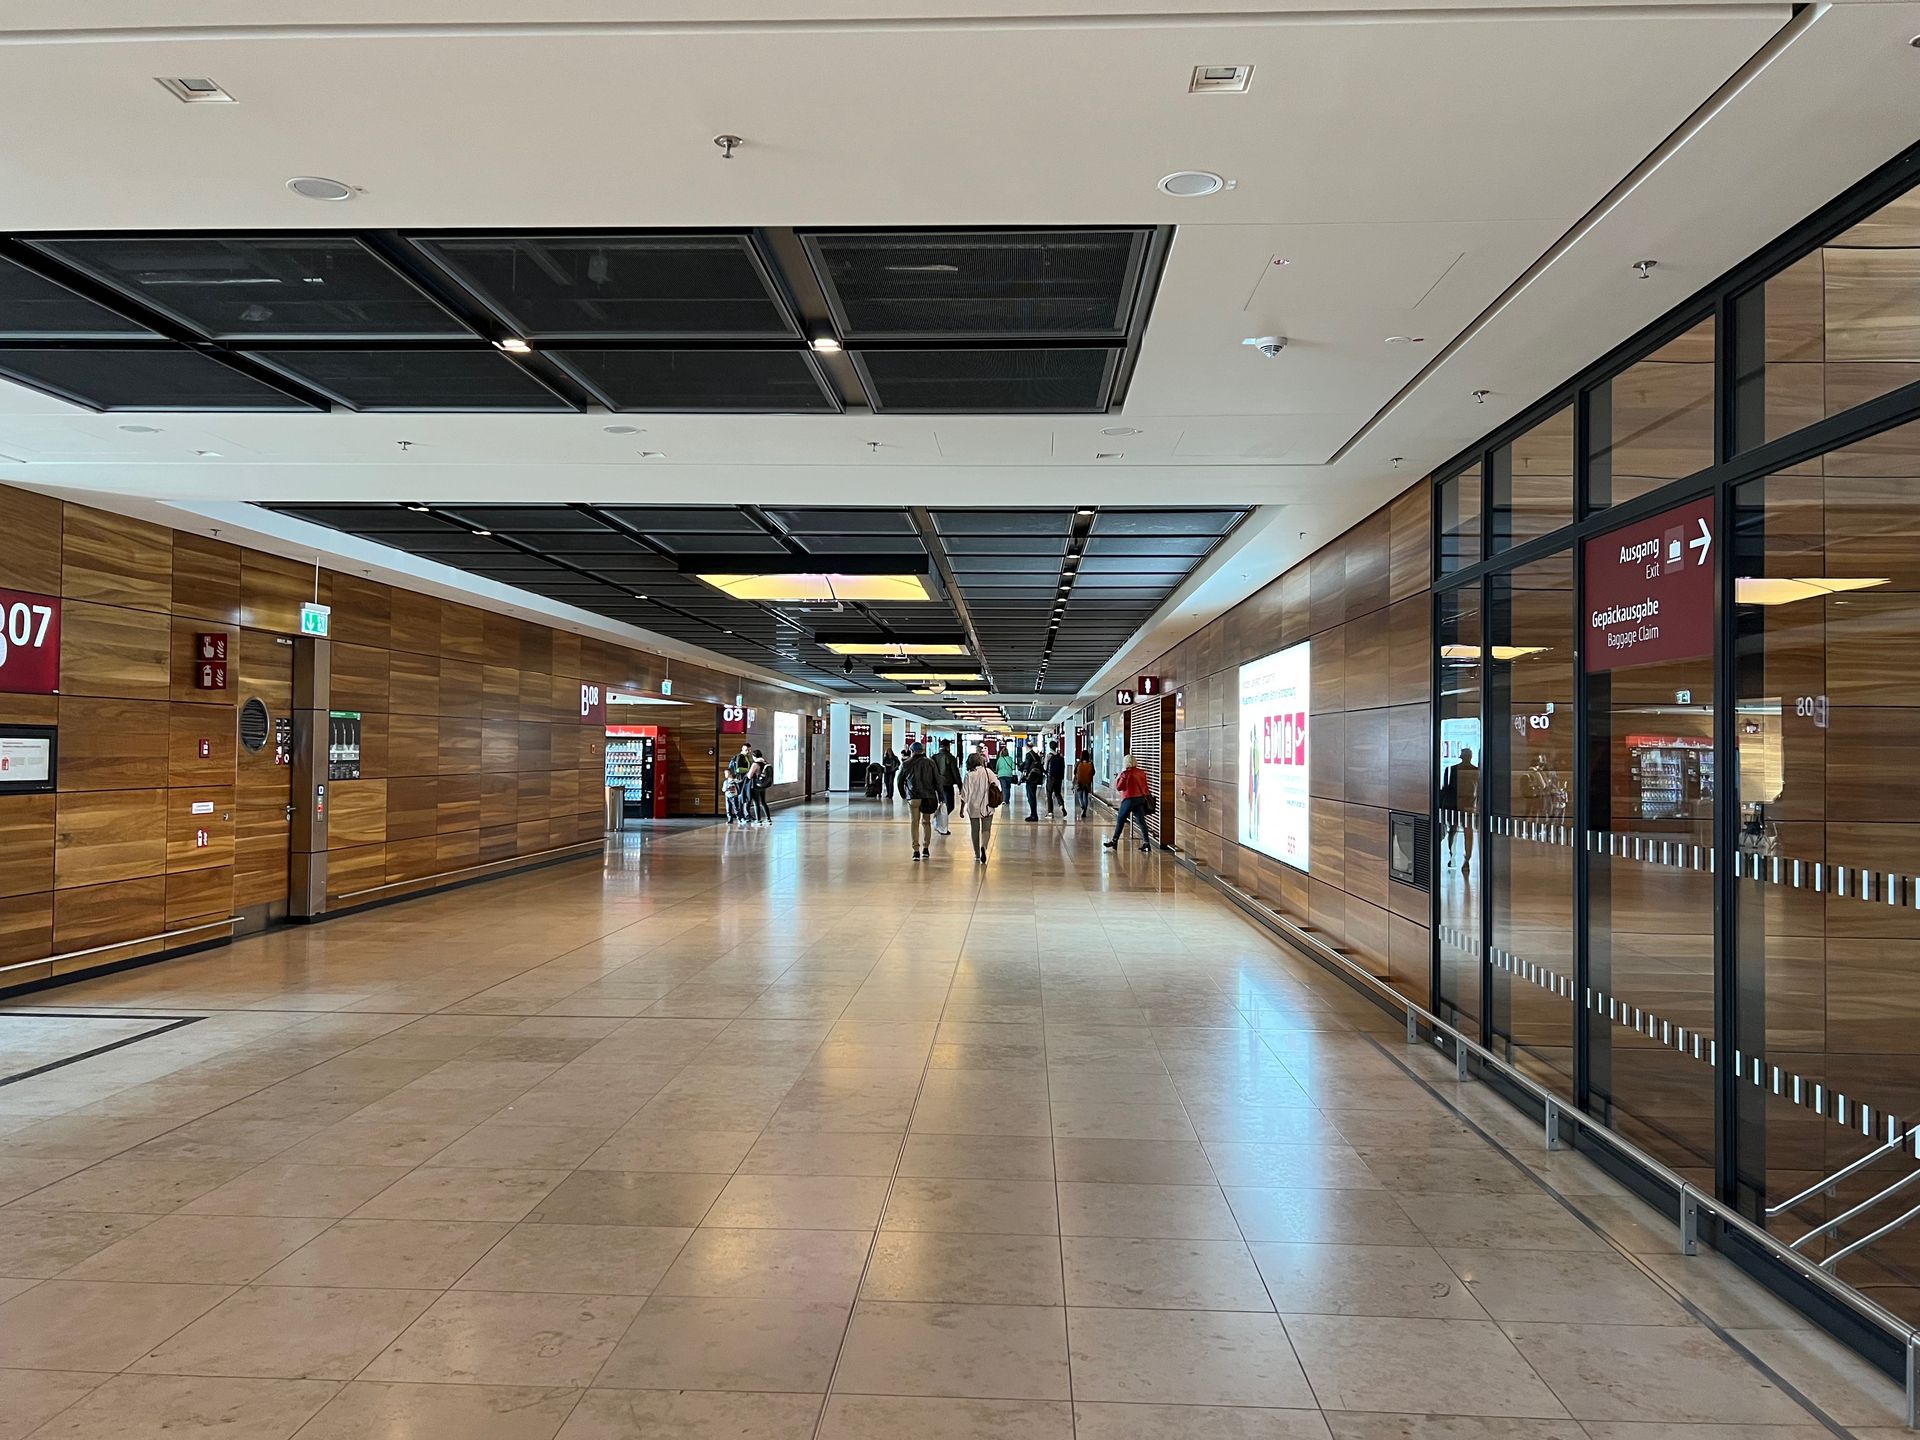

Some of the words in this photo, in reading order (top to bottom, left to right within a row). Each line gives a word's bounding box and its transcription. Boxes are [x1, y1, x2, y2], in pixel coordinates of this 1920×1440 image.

[1619, 538, 1660, 564] Ausgang
[1645, 562, 1660, 580] Exit
[1592, 597, 1659, 630] Gepäckausgabe
[1607, 629, 1637, 649] Baggage
[1638, 623, 1659, 642] Claim
[581, 685, 599, 715] B08
[723, 708, 743, 722] 09
